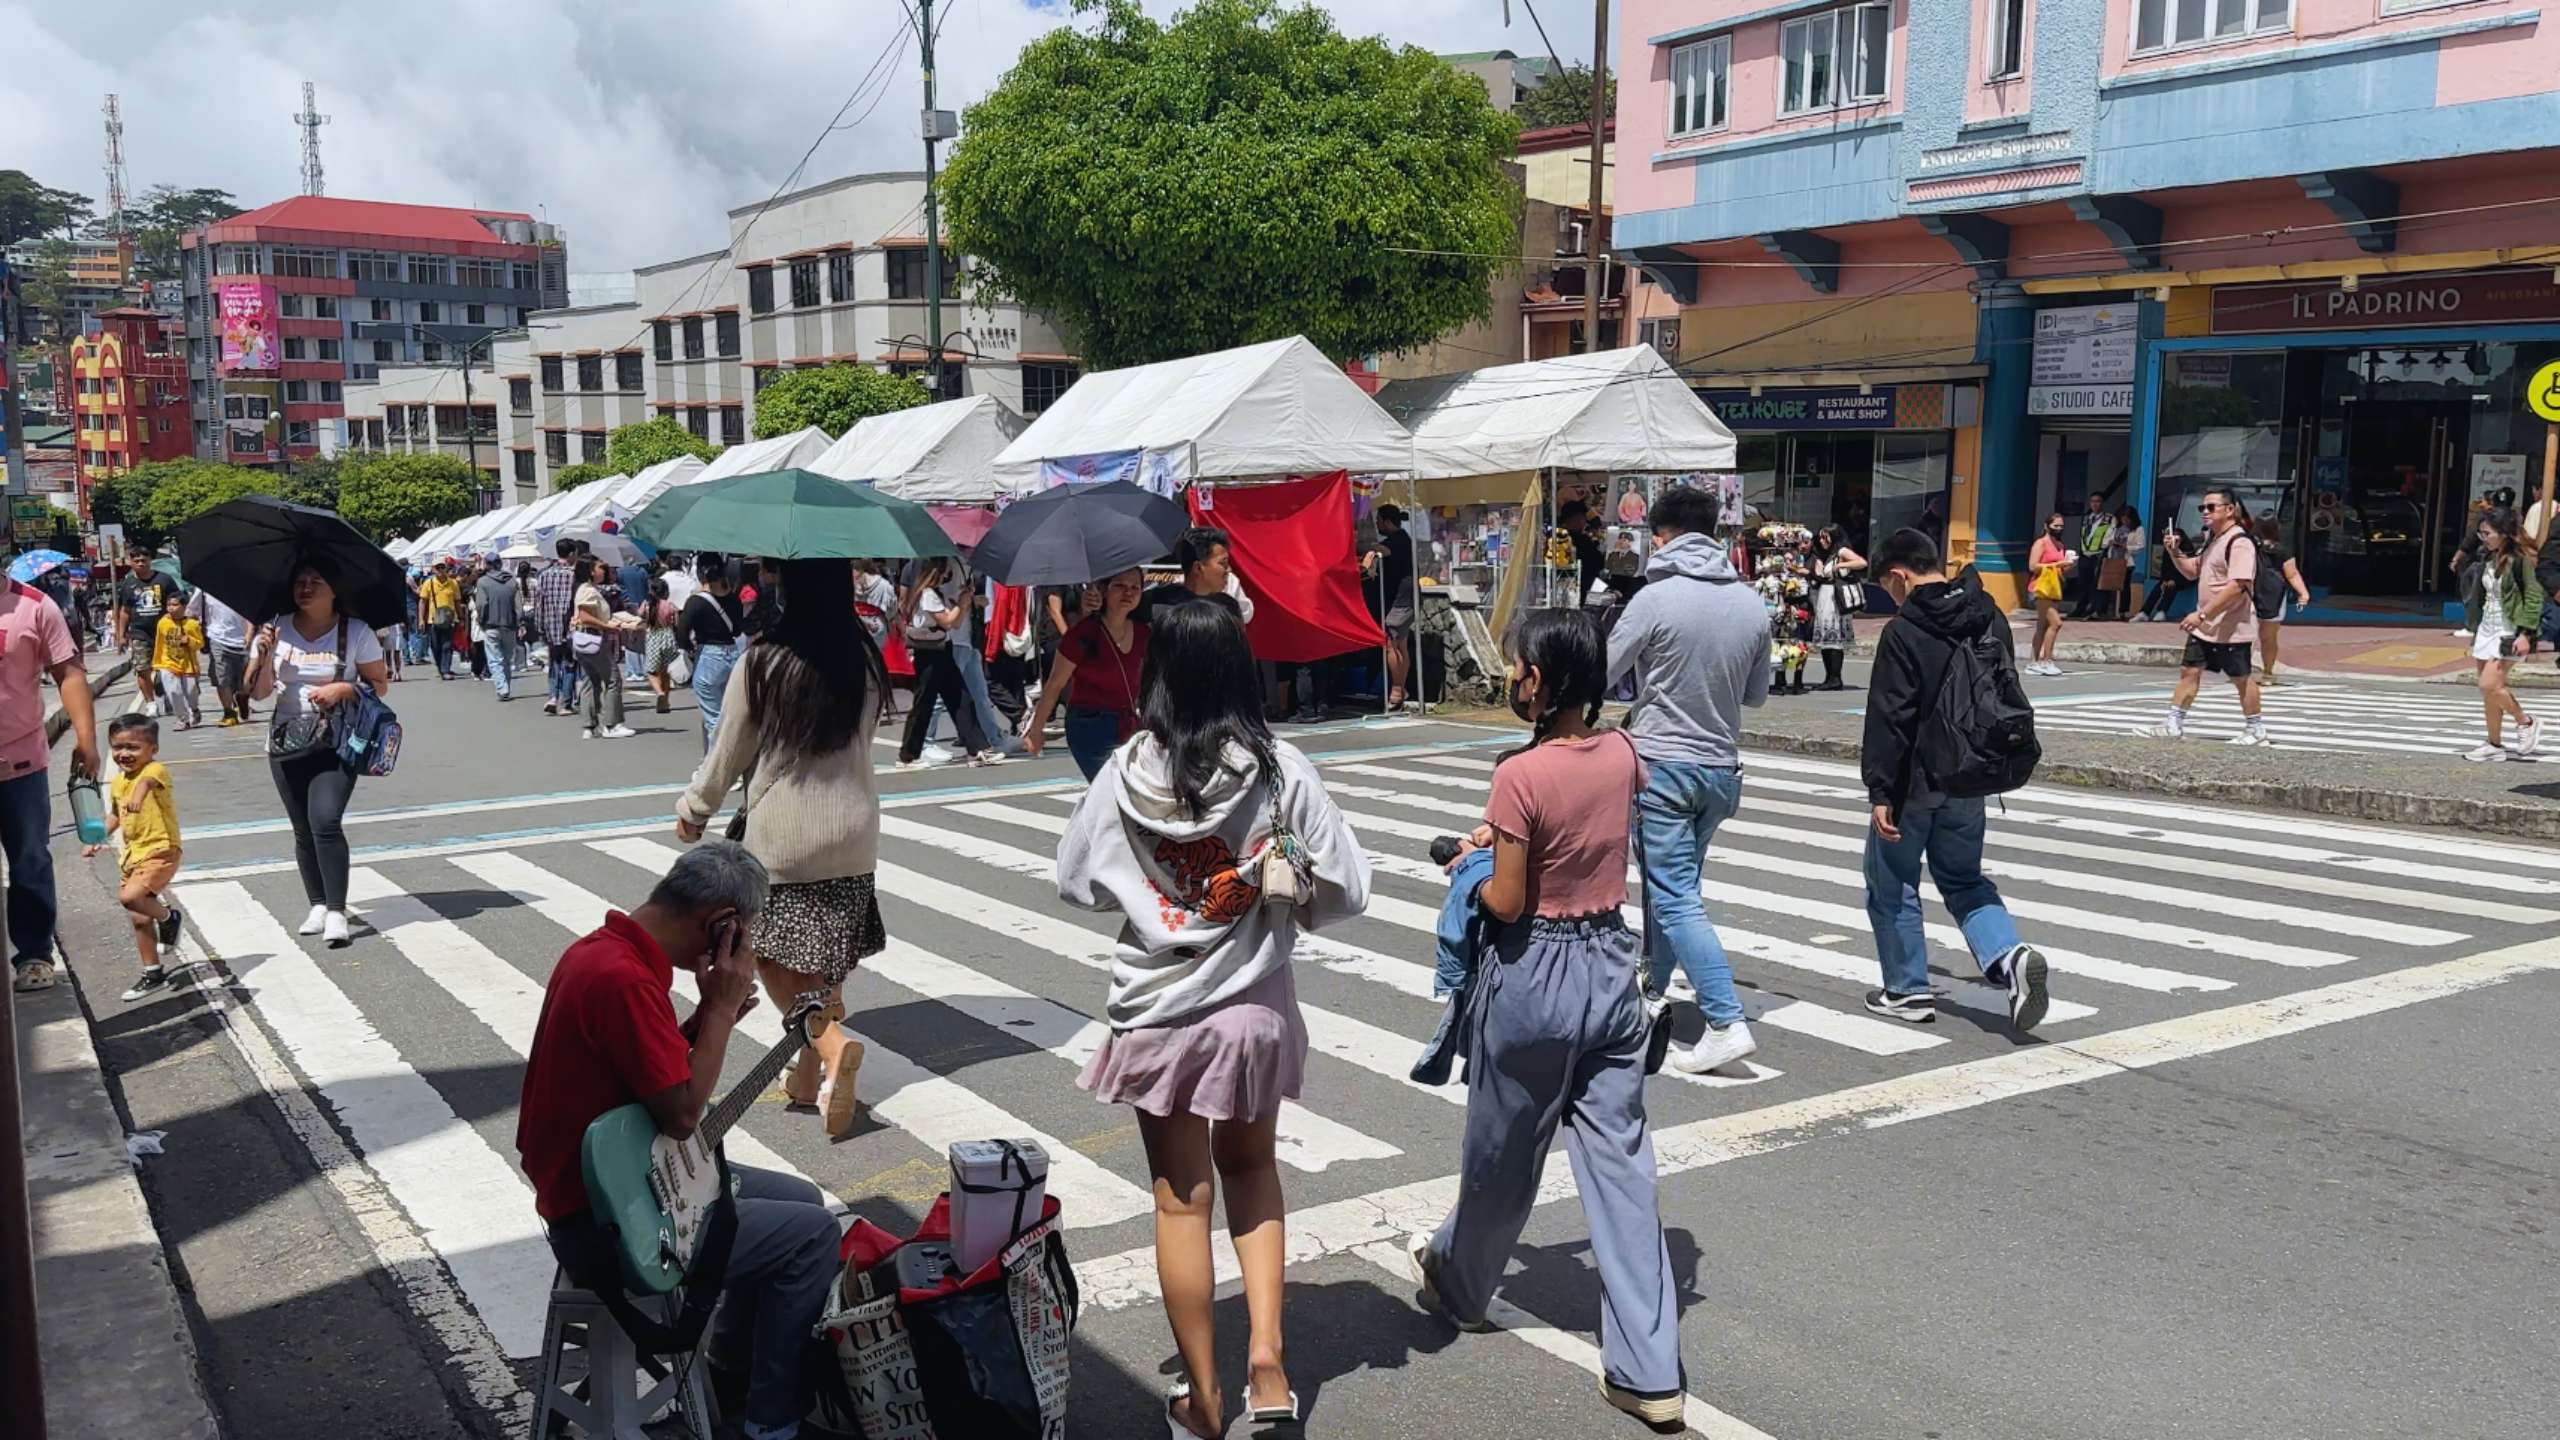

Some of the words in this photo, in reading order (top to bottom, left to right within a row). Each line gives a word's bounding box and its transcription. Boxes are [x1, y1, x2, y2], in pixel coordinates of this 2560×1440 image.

[2292, 293, 2316, 319] IL
[2327, 288, 2461, 318] PADRINO
[1751, 400, 1808, 420] HOUSE
[1817, 397, 1887, 409] RESTAURANT
[2051, 391, 2096, 409] STUDIO
[2101, 391, 2133, 408] CAFE
[1816, 410, 1824, 420] &
[1828, 409, 1855, 420] BAKE
[1858, 408, 1888, 420] SHOP
[1029, 1295, 1041, 1334] YORK
[847, 1313, 902, 1351] CIT
[863, 1337, 910, 1362] WITHOUT
[846, 1354, 898, 1377] WHATEVER
[882, 1366, 921, 1394] YO
[885, 1400, 929, 1431] STO
